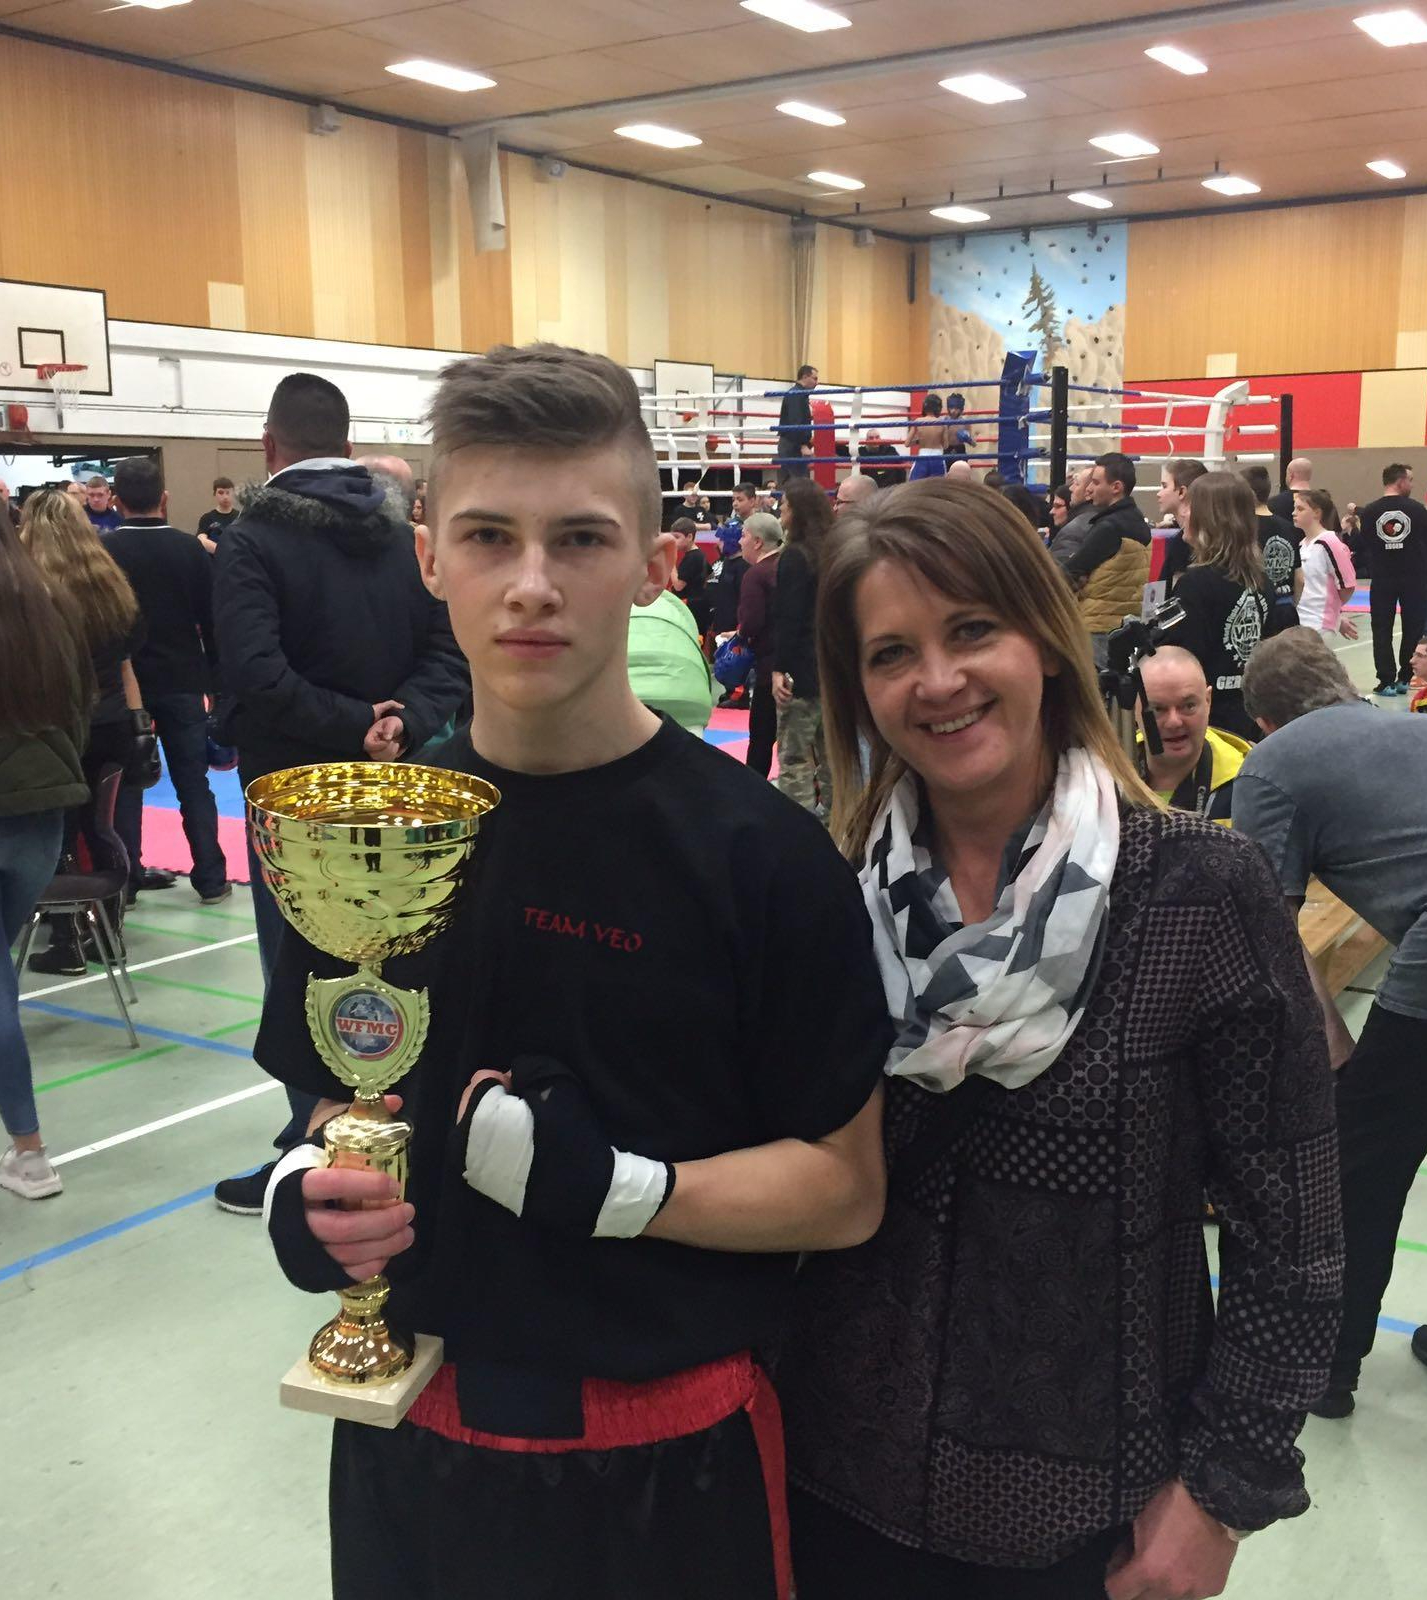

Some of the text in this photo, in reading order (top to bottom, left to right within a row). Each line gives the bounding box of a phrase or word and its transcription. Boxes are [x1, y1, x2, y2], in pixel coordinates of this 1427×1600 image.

[1216, 675, 1243, 690] GER
[523, 906, 643, 953] TEAM VEO
[336, 1017, 399, 1037] WFMC
